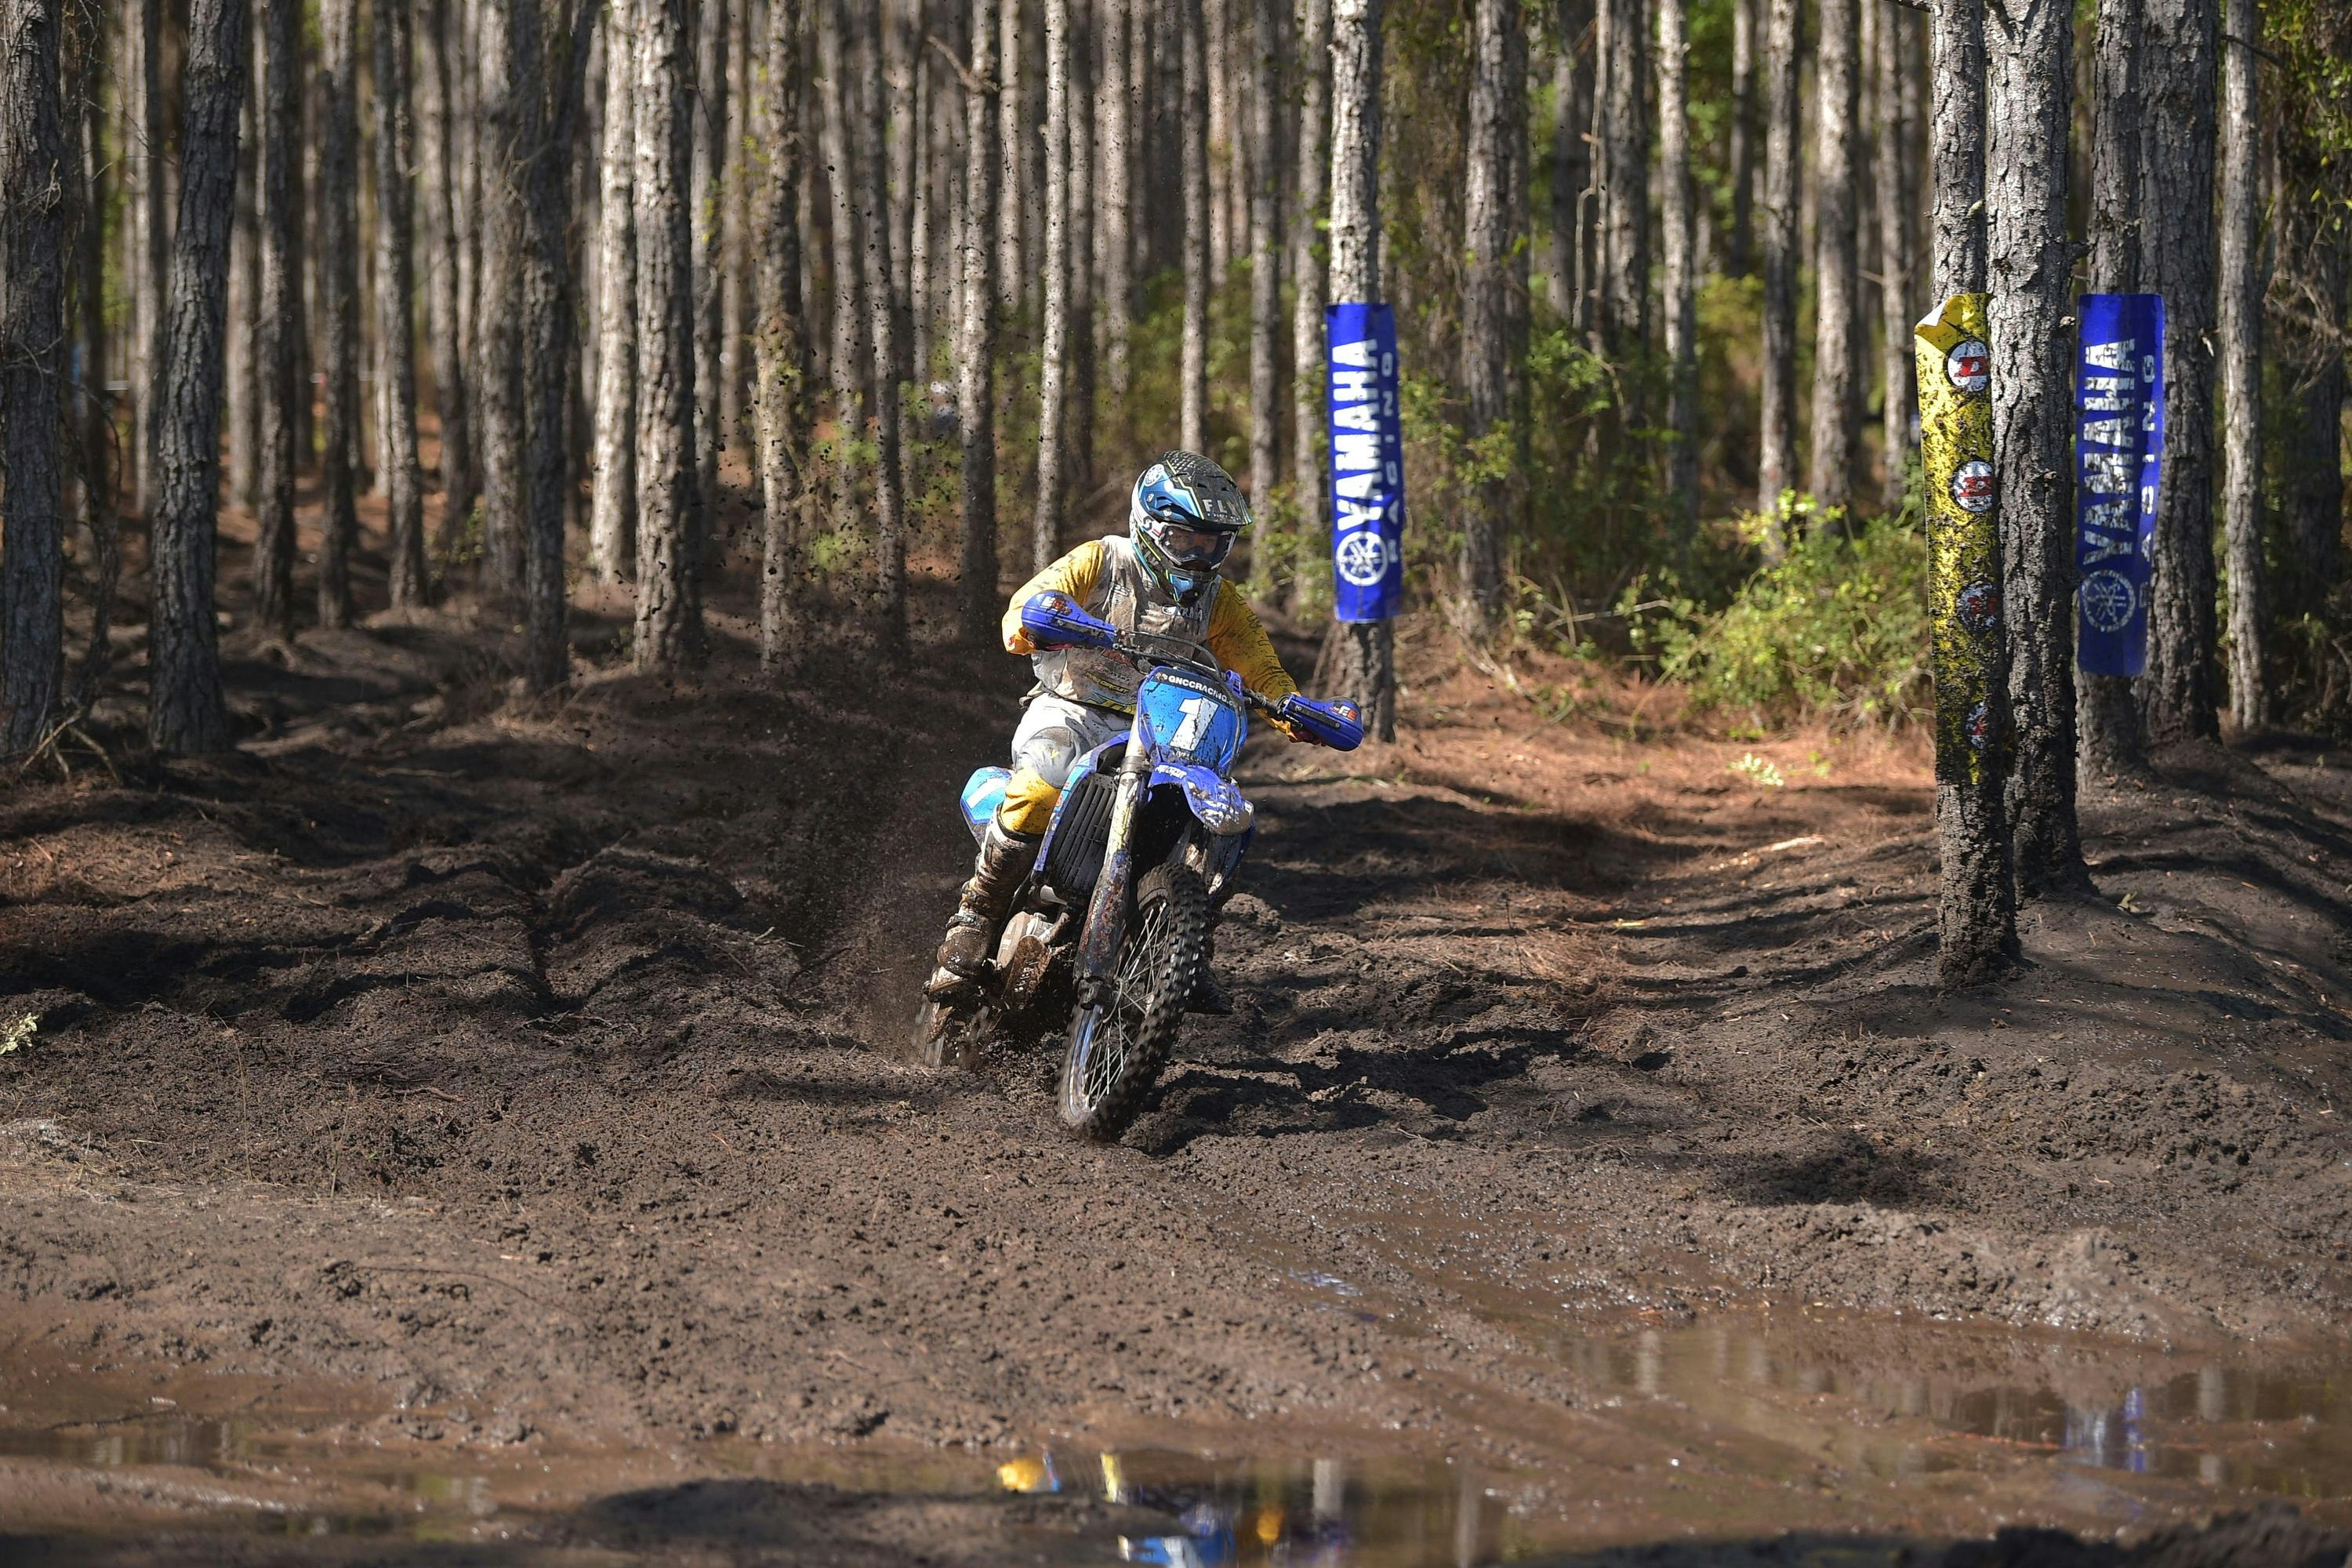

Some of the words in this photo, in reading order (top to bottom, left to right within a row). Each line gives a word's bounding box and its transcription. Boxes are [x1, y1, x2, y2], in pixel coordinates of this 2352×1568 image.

[1331, 338, 1385, 532] YAMAHA
[2082, 337, 2136, 566] YAMAHA
[1099, 679, 1131, 694] CIRCUIT
[1169, 696, 1219, 751] 1
